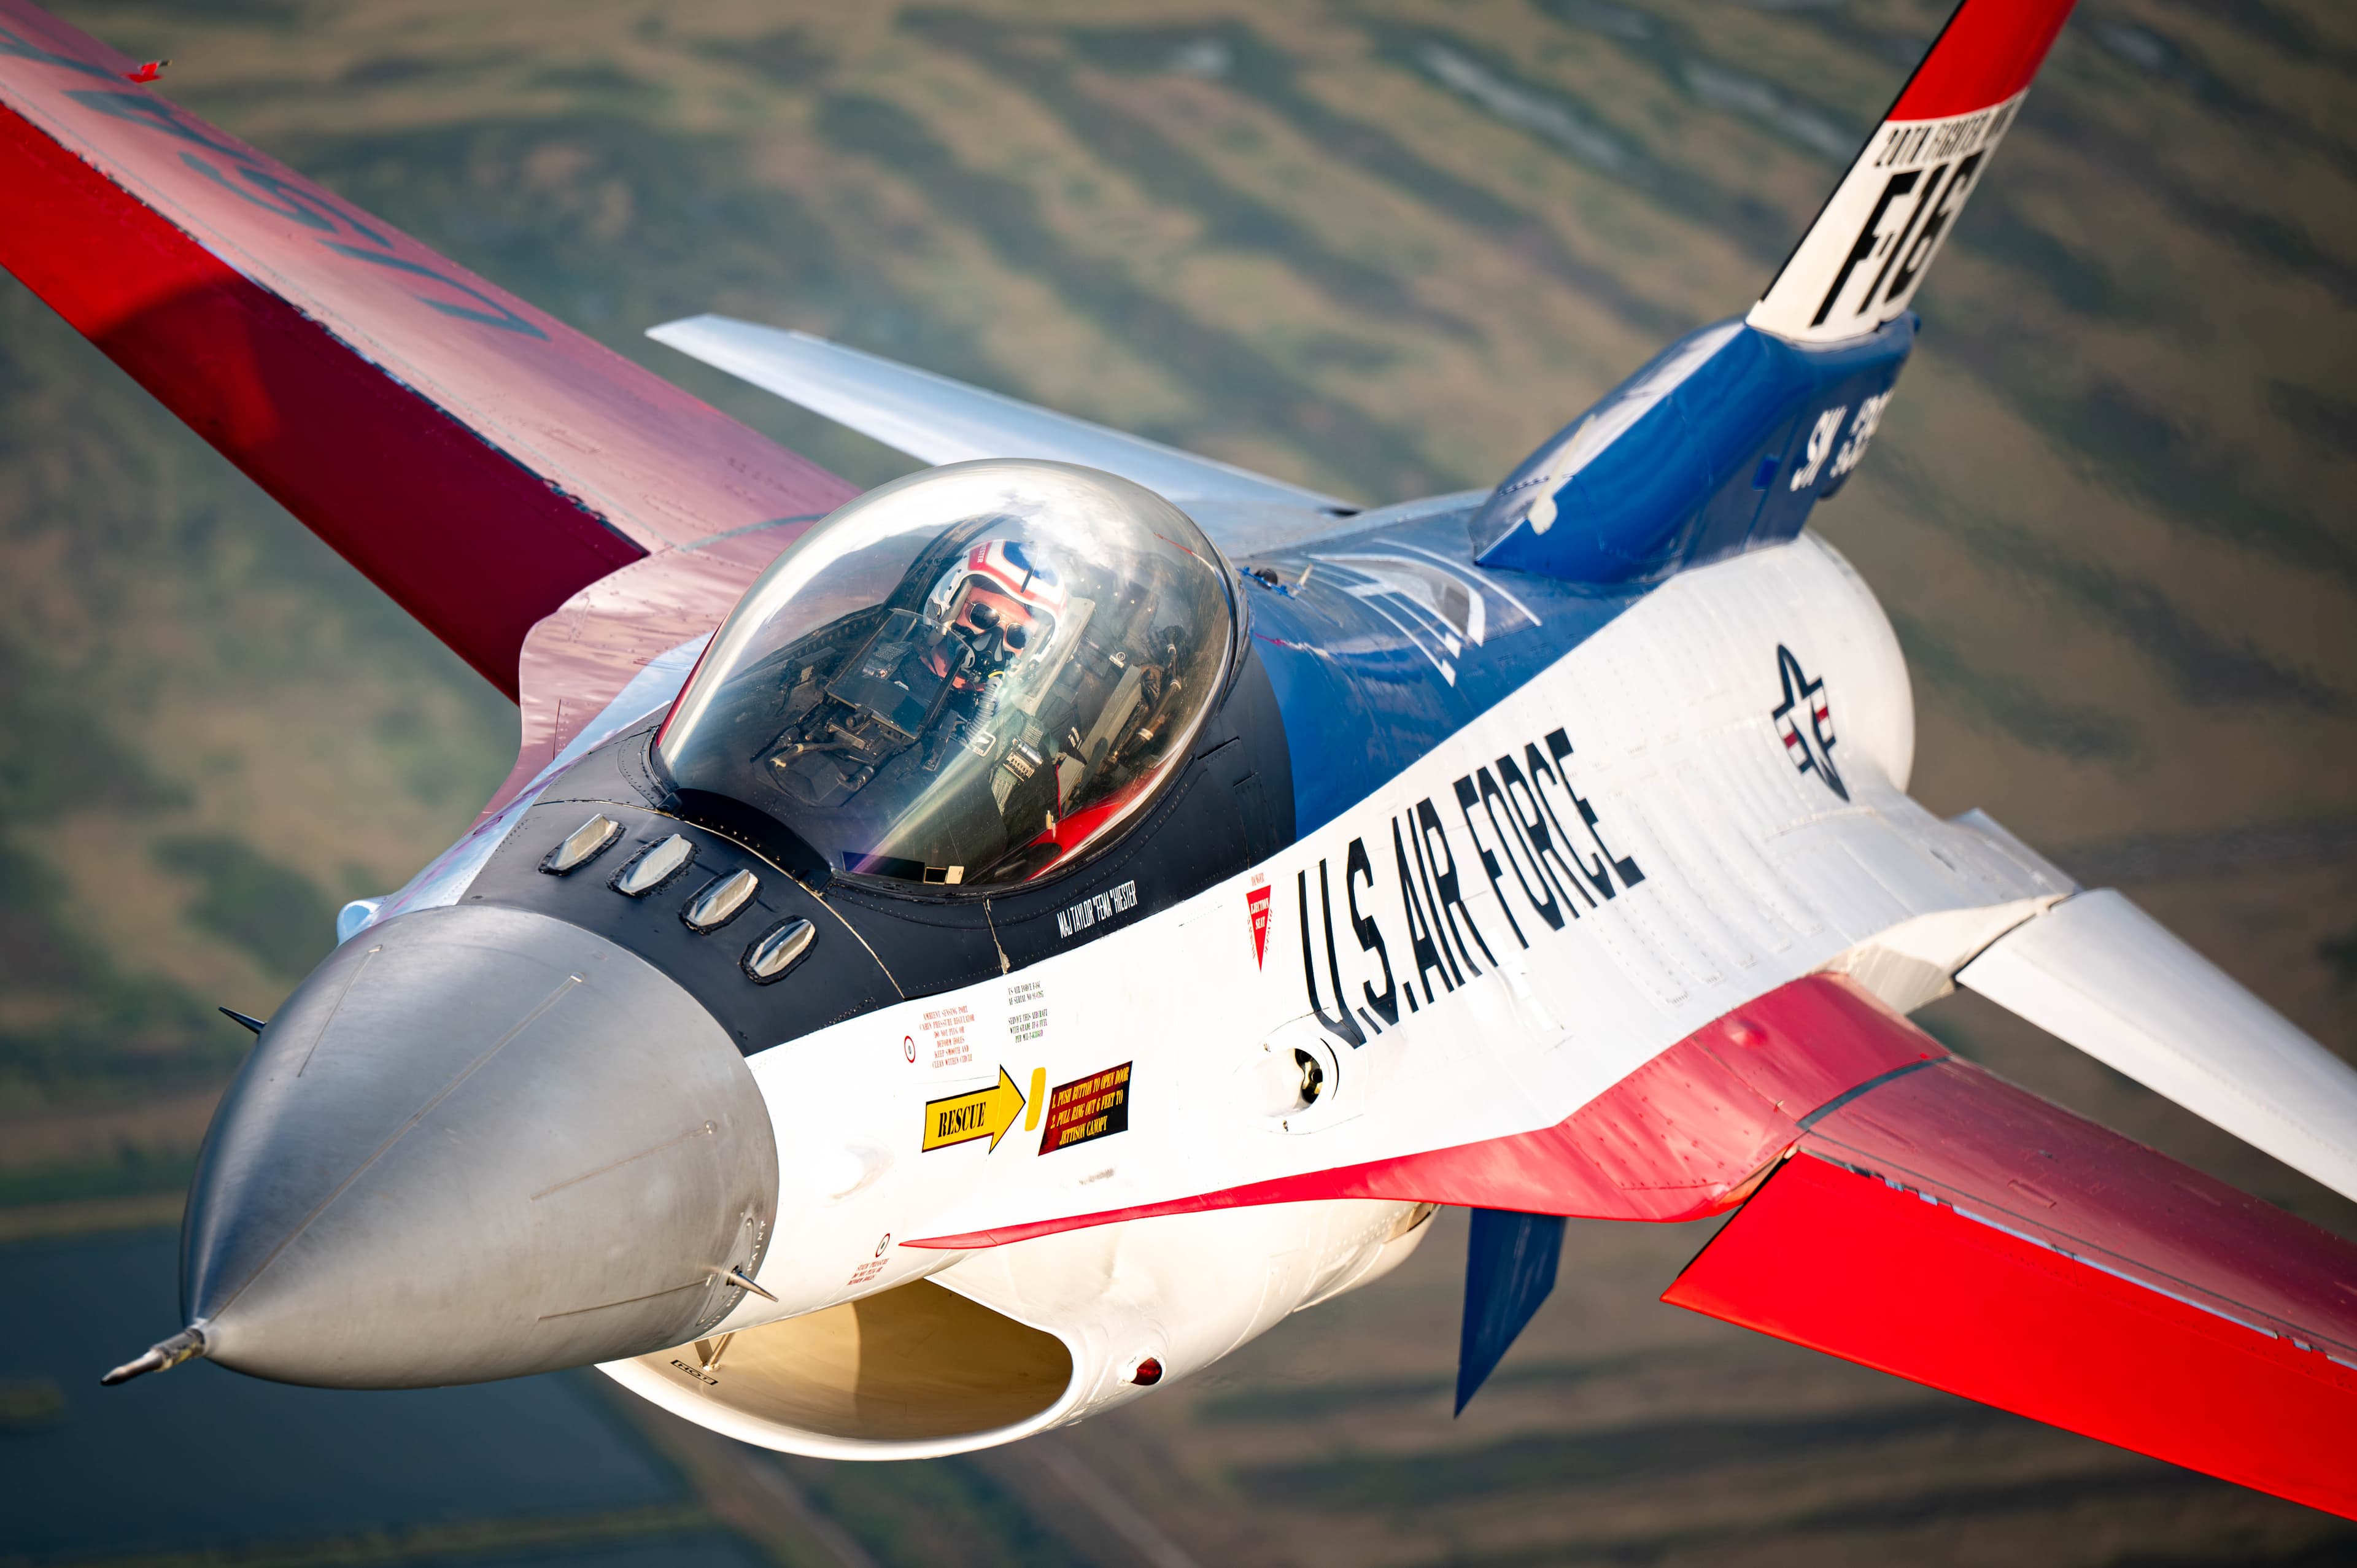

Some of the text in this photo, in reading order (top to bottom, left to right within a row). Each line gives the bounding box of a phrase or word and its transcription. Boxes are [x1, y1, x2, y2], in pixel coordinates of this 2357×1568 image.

[1808, 149, 1986, 329] F-16
[1298, 727, 1646, 1049] U.S. AIR FORCE
[1250, 897, 1269, 914] EJECTION
[1057, 909, 1073, 939] MAJ
[1070, 898, 1095, 933] TAYLOR
[1255, 916, 1266, 930] SEAT
[1021, 983, 1032, 992] FORCE
[1014, 995, 1026, 1004] SERIAL
[958, 1005, 967, 1014] PORT
[1008, 1008, 1048, 1025] SERVICE THIS AIRCRAFT
[933, 1018, 953, 1029] PRESSURE
[953, 1014, 975, 1025] REGULATOR
[1010, 1025, 1020, 1034] WITH
[1020, 1022, 1031, 1032] GRADE
[937, 1036, 964, 1048] DEFORM HOLES
[945, 1046, 961, 1056] SMOOTH
[932, 1054, 972, 1068] CLEAN WITHIN CIRCLE
[1051, 1067, 1129, 1109] 1. PUSH BUTTON TO OPEN DOOR
[1050, 1089, 1123, 1129] 2. PULL RING OUT 6 FEET TO
[938, 1102, 986, 1138] RESCUE
[1059, 1116, 1108, 1146] JETTISON CANOPY
